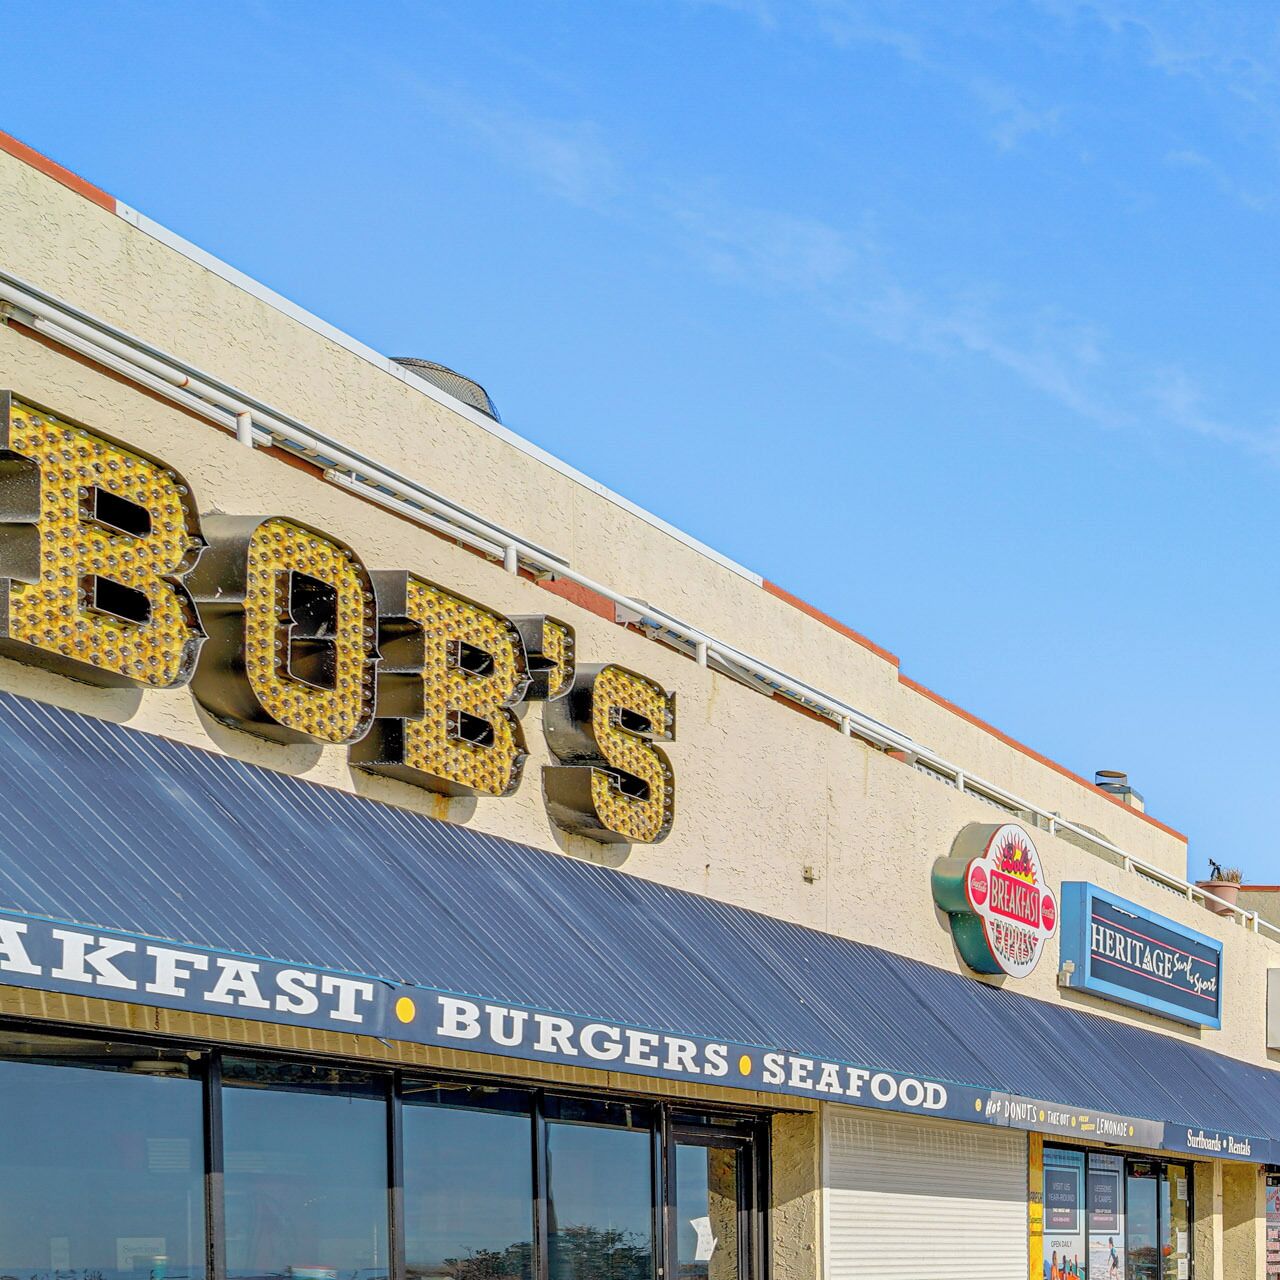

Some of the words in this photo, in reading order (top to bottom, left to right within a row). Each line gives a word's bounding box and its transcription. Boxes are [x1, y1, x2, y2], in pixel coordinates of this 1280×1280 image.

[0, 391, 677, 845] BOB'S
[990, 875, 1040, 926] BREAKFAST
[992, 918, 1038, 966] EXPRESS
[1091, 922, 1174, 979] HERITAGE
[1173, 953, 1193, 982] Surf
[1194, 973, 1217, 996] Sport
[437, 996, 730, 1077] BURGERS
[762, 1052, 948, 1111] SEAFOOD
[985, 1099, 1001, 1118] Hot
[1004, 1101, 1037, 1123] DONUTS
[1096, 1118, 1128, 1137] LEMONADE
[1187, 1129, 1221, 1152] Surfboards
[1228, 1136, 1251, 1156] Rentals
[1051, 1240, 1062, 1248] OPEN
[1061, 1240, 1072, 1248] DAILY
